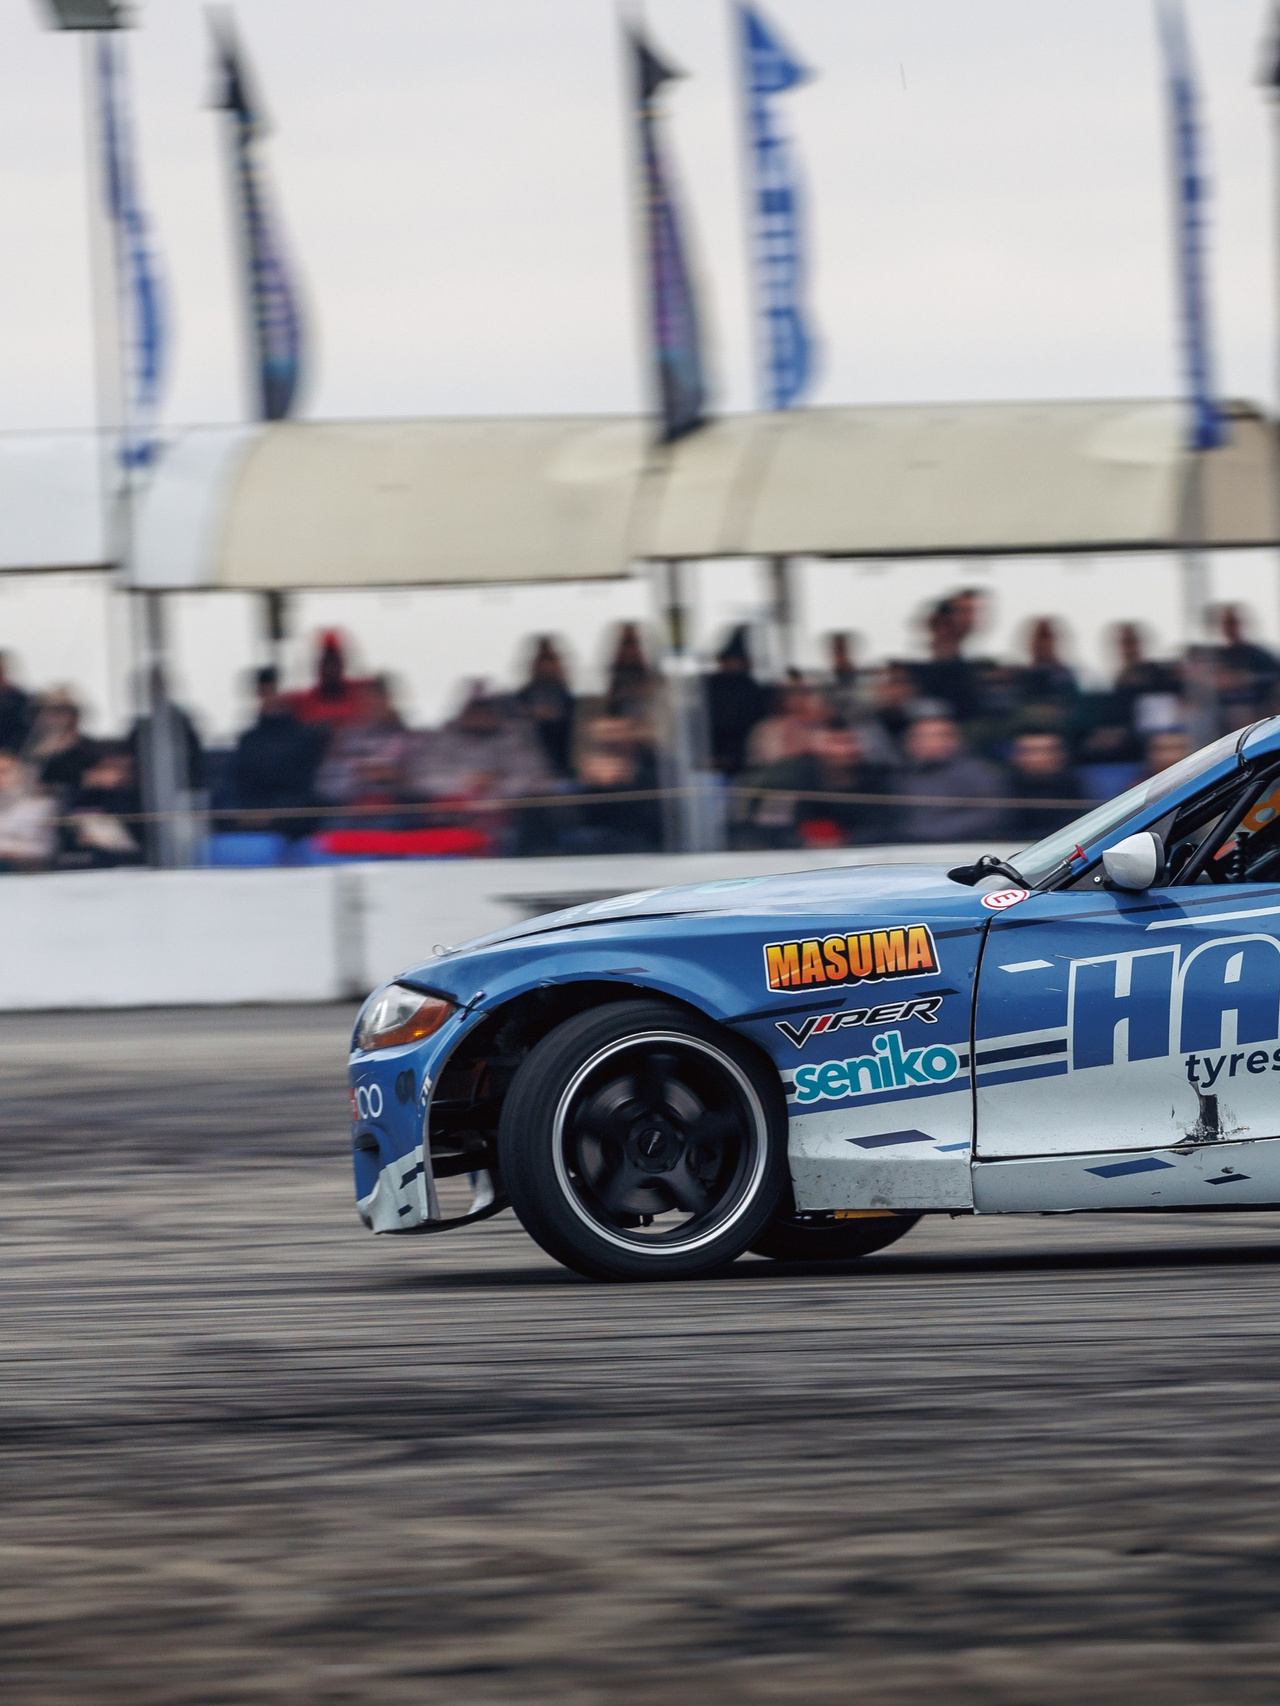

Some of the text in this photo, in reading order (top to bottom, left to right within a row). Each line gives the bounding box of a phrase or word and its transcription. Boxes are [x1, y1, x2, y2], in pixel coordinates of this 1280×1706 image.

[766, 925, 936, 989] MASUMA
[776, 998, 942, 1048] VIPER
[795, 1033, 958, 1101] seniko
